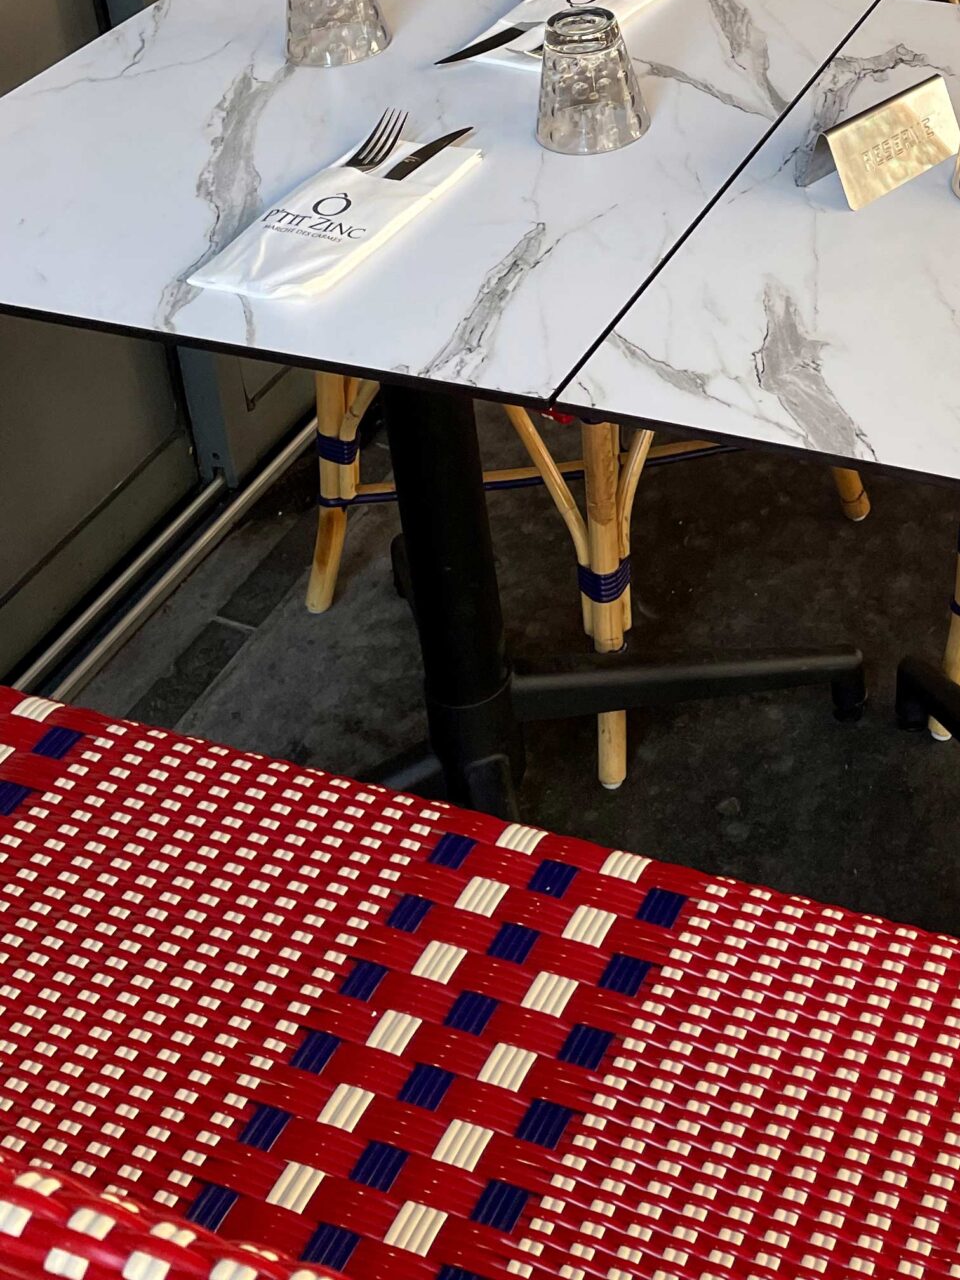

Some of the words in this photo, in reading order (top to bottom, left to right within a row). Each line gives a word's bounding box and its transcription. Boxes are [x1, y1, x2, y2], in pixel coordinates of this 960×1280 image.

[312, 192, 352, 217] Ô
[261, 208, 312, 227] P'TIT
[308, 216, 367, 240] ZINC
